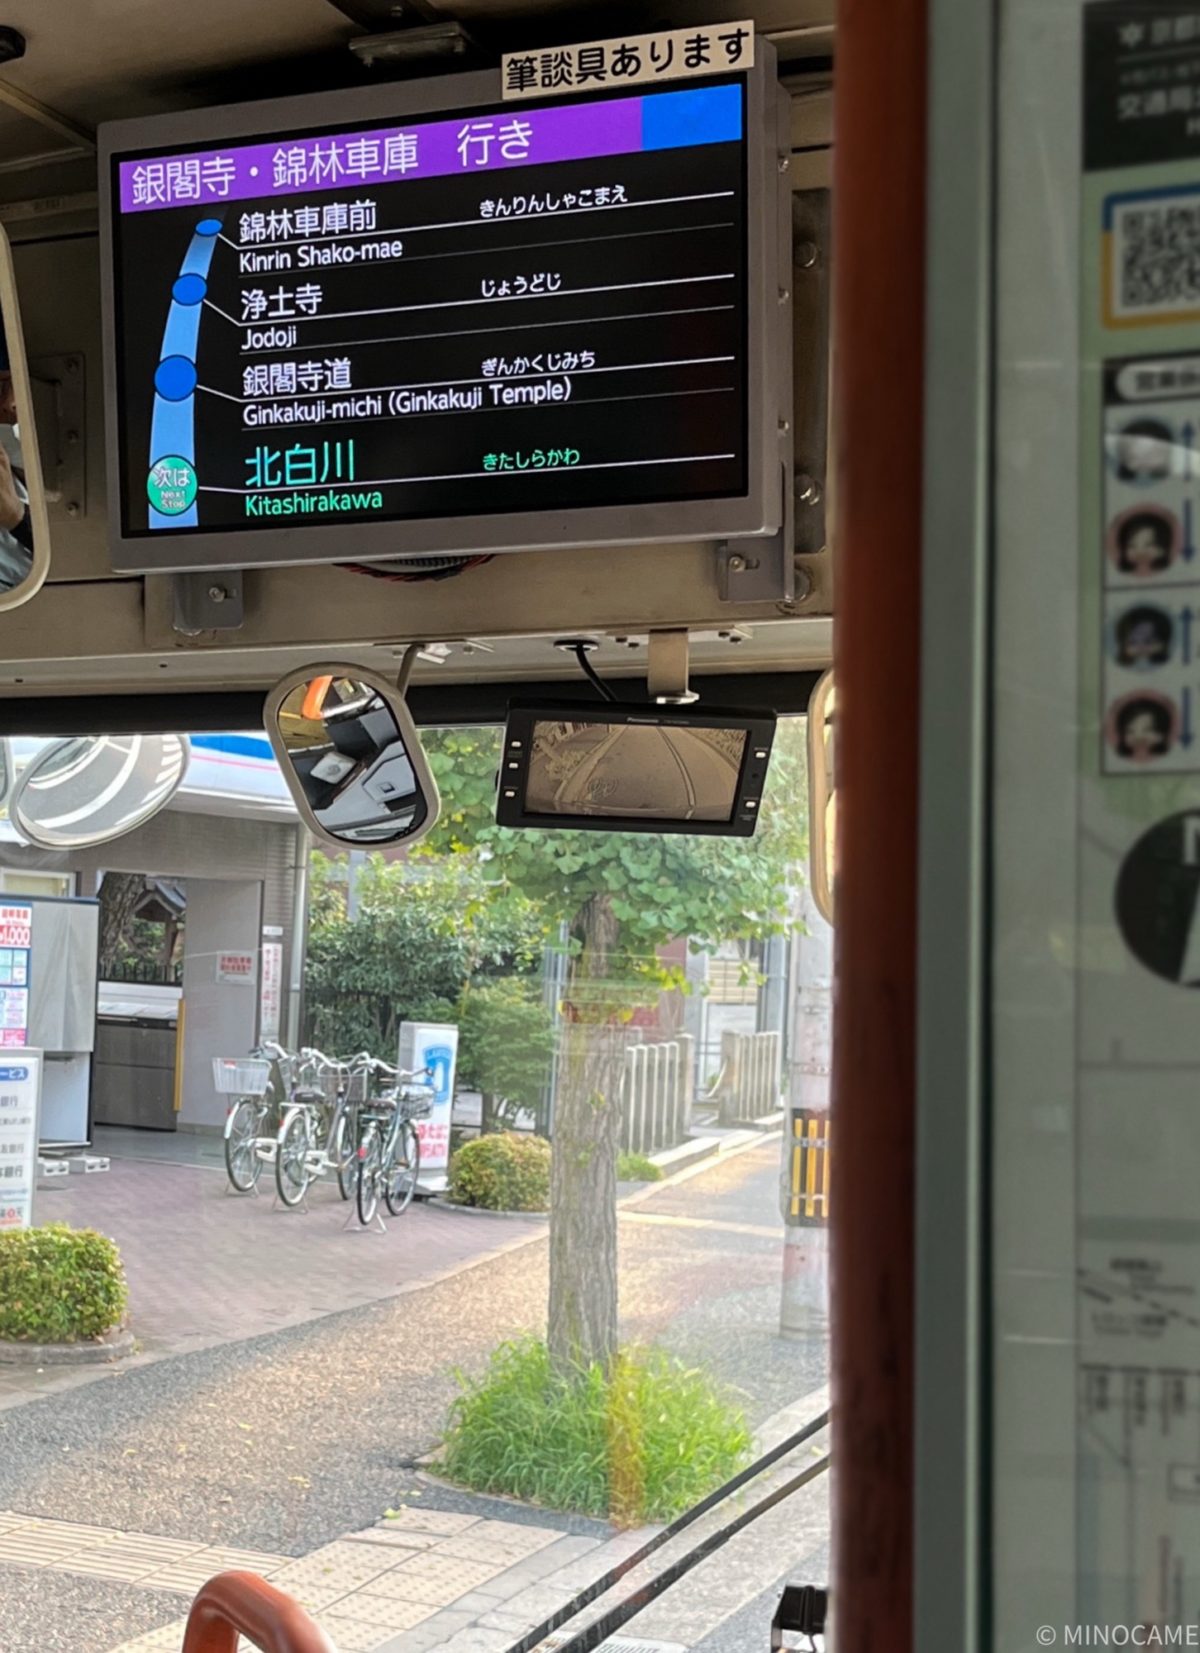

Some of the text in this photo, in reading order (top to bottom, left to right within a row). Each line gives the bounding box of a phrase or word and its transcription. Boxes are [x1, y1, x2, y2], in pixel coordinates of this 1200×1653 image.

[506, 28, 750, 92] 筆談具あります
[131, 119, 533, 206] 銀閣寺・錦林車庫 行き
[479, 184, 628, 218] きんりんしゃこまえ
[238, 199, 377, 244] 錦林車庫前
[239, 239, 403, 273] Kinrin Shako-mae
[240, 282, 323, 321] 浄土寺
[481, 272, 562, 298] じょうどじ
[241, 326, 298, 351] Jodoji
[242, 358, 352, 397] 銀閣寺道
[481, 350, 596, 377] ぎんかくじみち
[243, 375, 572, 427] Ginkakuji-michi (Ginkakuji Temple)
[244, 439, 355, 488] 北白川
[482, 448, 581, 471] きたしらかわ
[153, 467, 190, 488] 次は
[245, 488, 383, 517] Kitashirakawa
